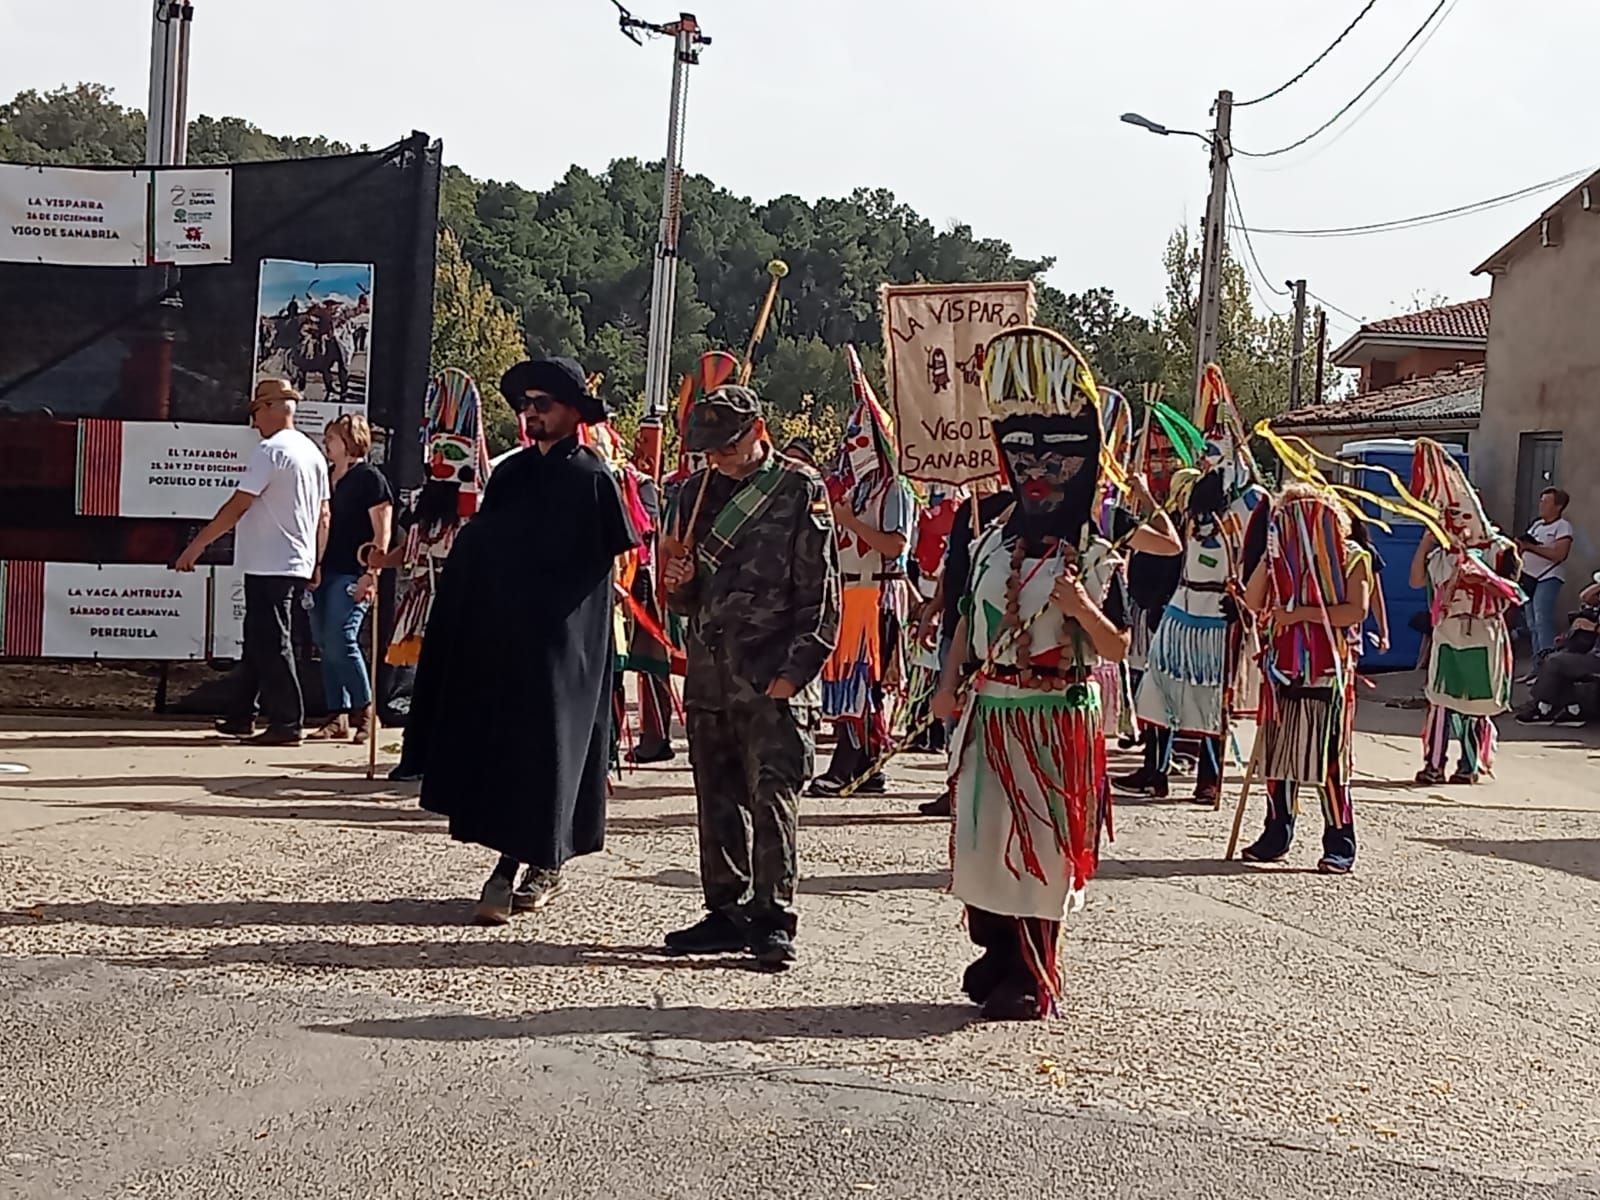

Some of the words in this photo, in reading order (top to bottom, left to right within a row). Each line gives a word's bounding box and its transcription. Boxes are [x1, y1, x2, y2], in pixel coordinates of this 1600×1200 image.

[28, 198, 42, 206] LA
[46, 198, 104, 209] VISPARRA
[26, 212, 37, 220] 26
[39, 212, 50, 221] DE
[53, 213, 104, 223] DICIEMBRE
[11, 226, 41, 236] VIGO
[43, 227, 58, 237] DE
[60, 228, 120, 240] SANABRIA
[892, 317, 925, 343] LA
[929, 298, 1020, 328] VISPARR
[921, 416, 973, 441] VIGO
[978, 417, 991, 441] D
[168, 448, 179, 457] EL
[182, 448, 238, 460] TAFARRÓN
[904, 444, 995, 473] SANABR
[164, 462, 174, 470] 26
[183, 463, 193, 471] 27
[194, 463, 205, 472] DE
[149, 476, 197, 486] POZUELO
[198, 478, 212, 487] DE
[68, 588, 82, 596] LA
[86, 588, 118, 597] VACA
[121, 589, 182, 598] ANTRUEJA
[69, 605, 110, 616] SÁBADO
[112, 607, 125, 616] DE
[127, 607, 180, 617] CARNAVAL
[90, 627, 158, 638] PERERUELA
